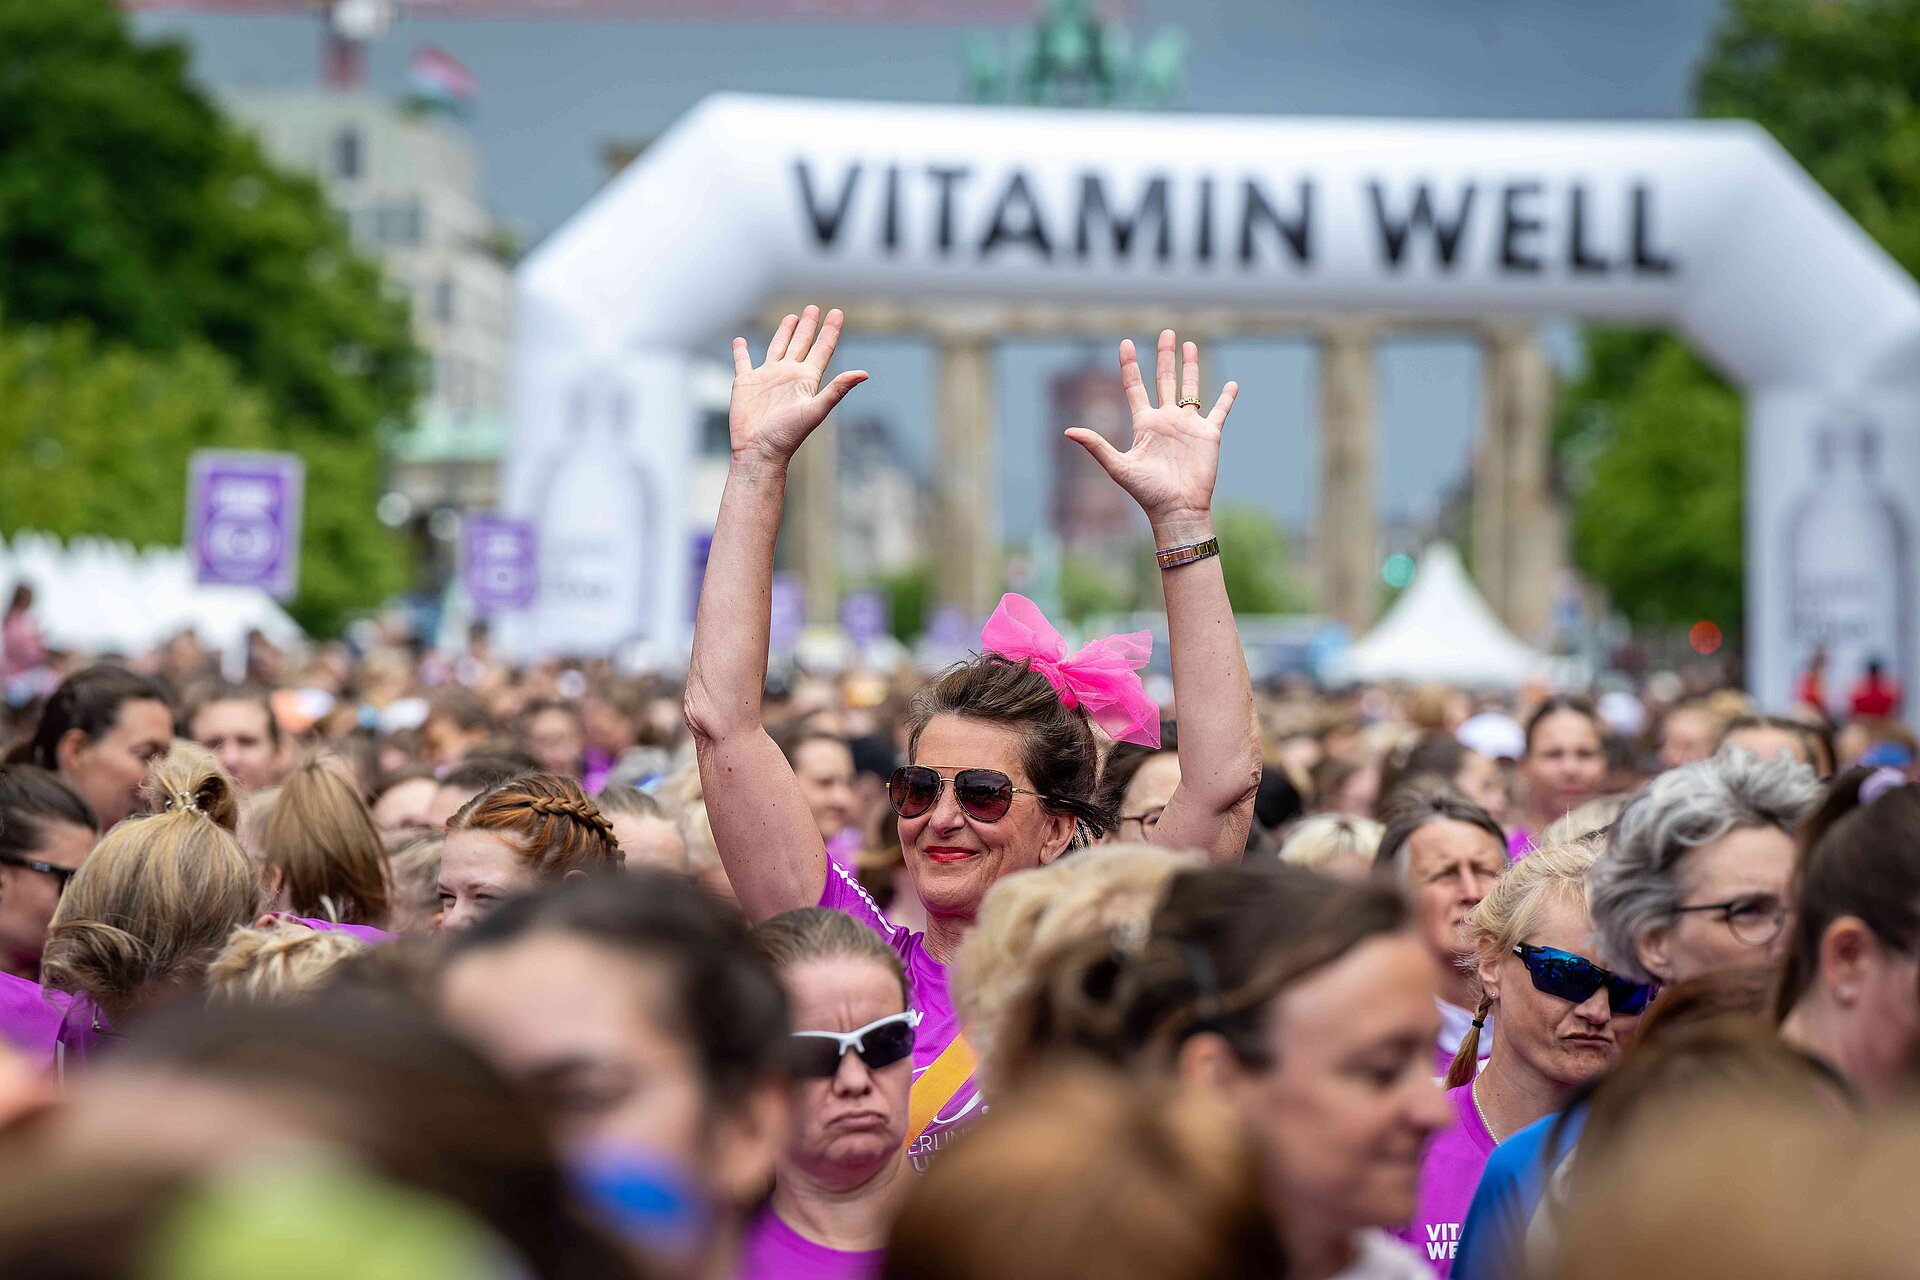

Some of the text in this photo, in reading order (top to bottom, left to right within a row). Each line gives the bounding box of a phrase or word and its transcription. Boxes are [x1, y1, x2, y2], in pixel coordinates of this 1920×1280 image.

[793, 158, 1682, 283] VITAMIN WELL
[1425, 1222, 1465, 1241] VIT
